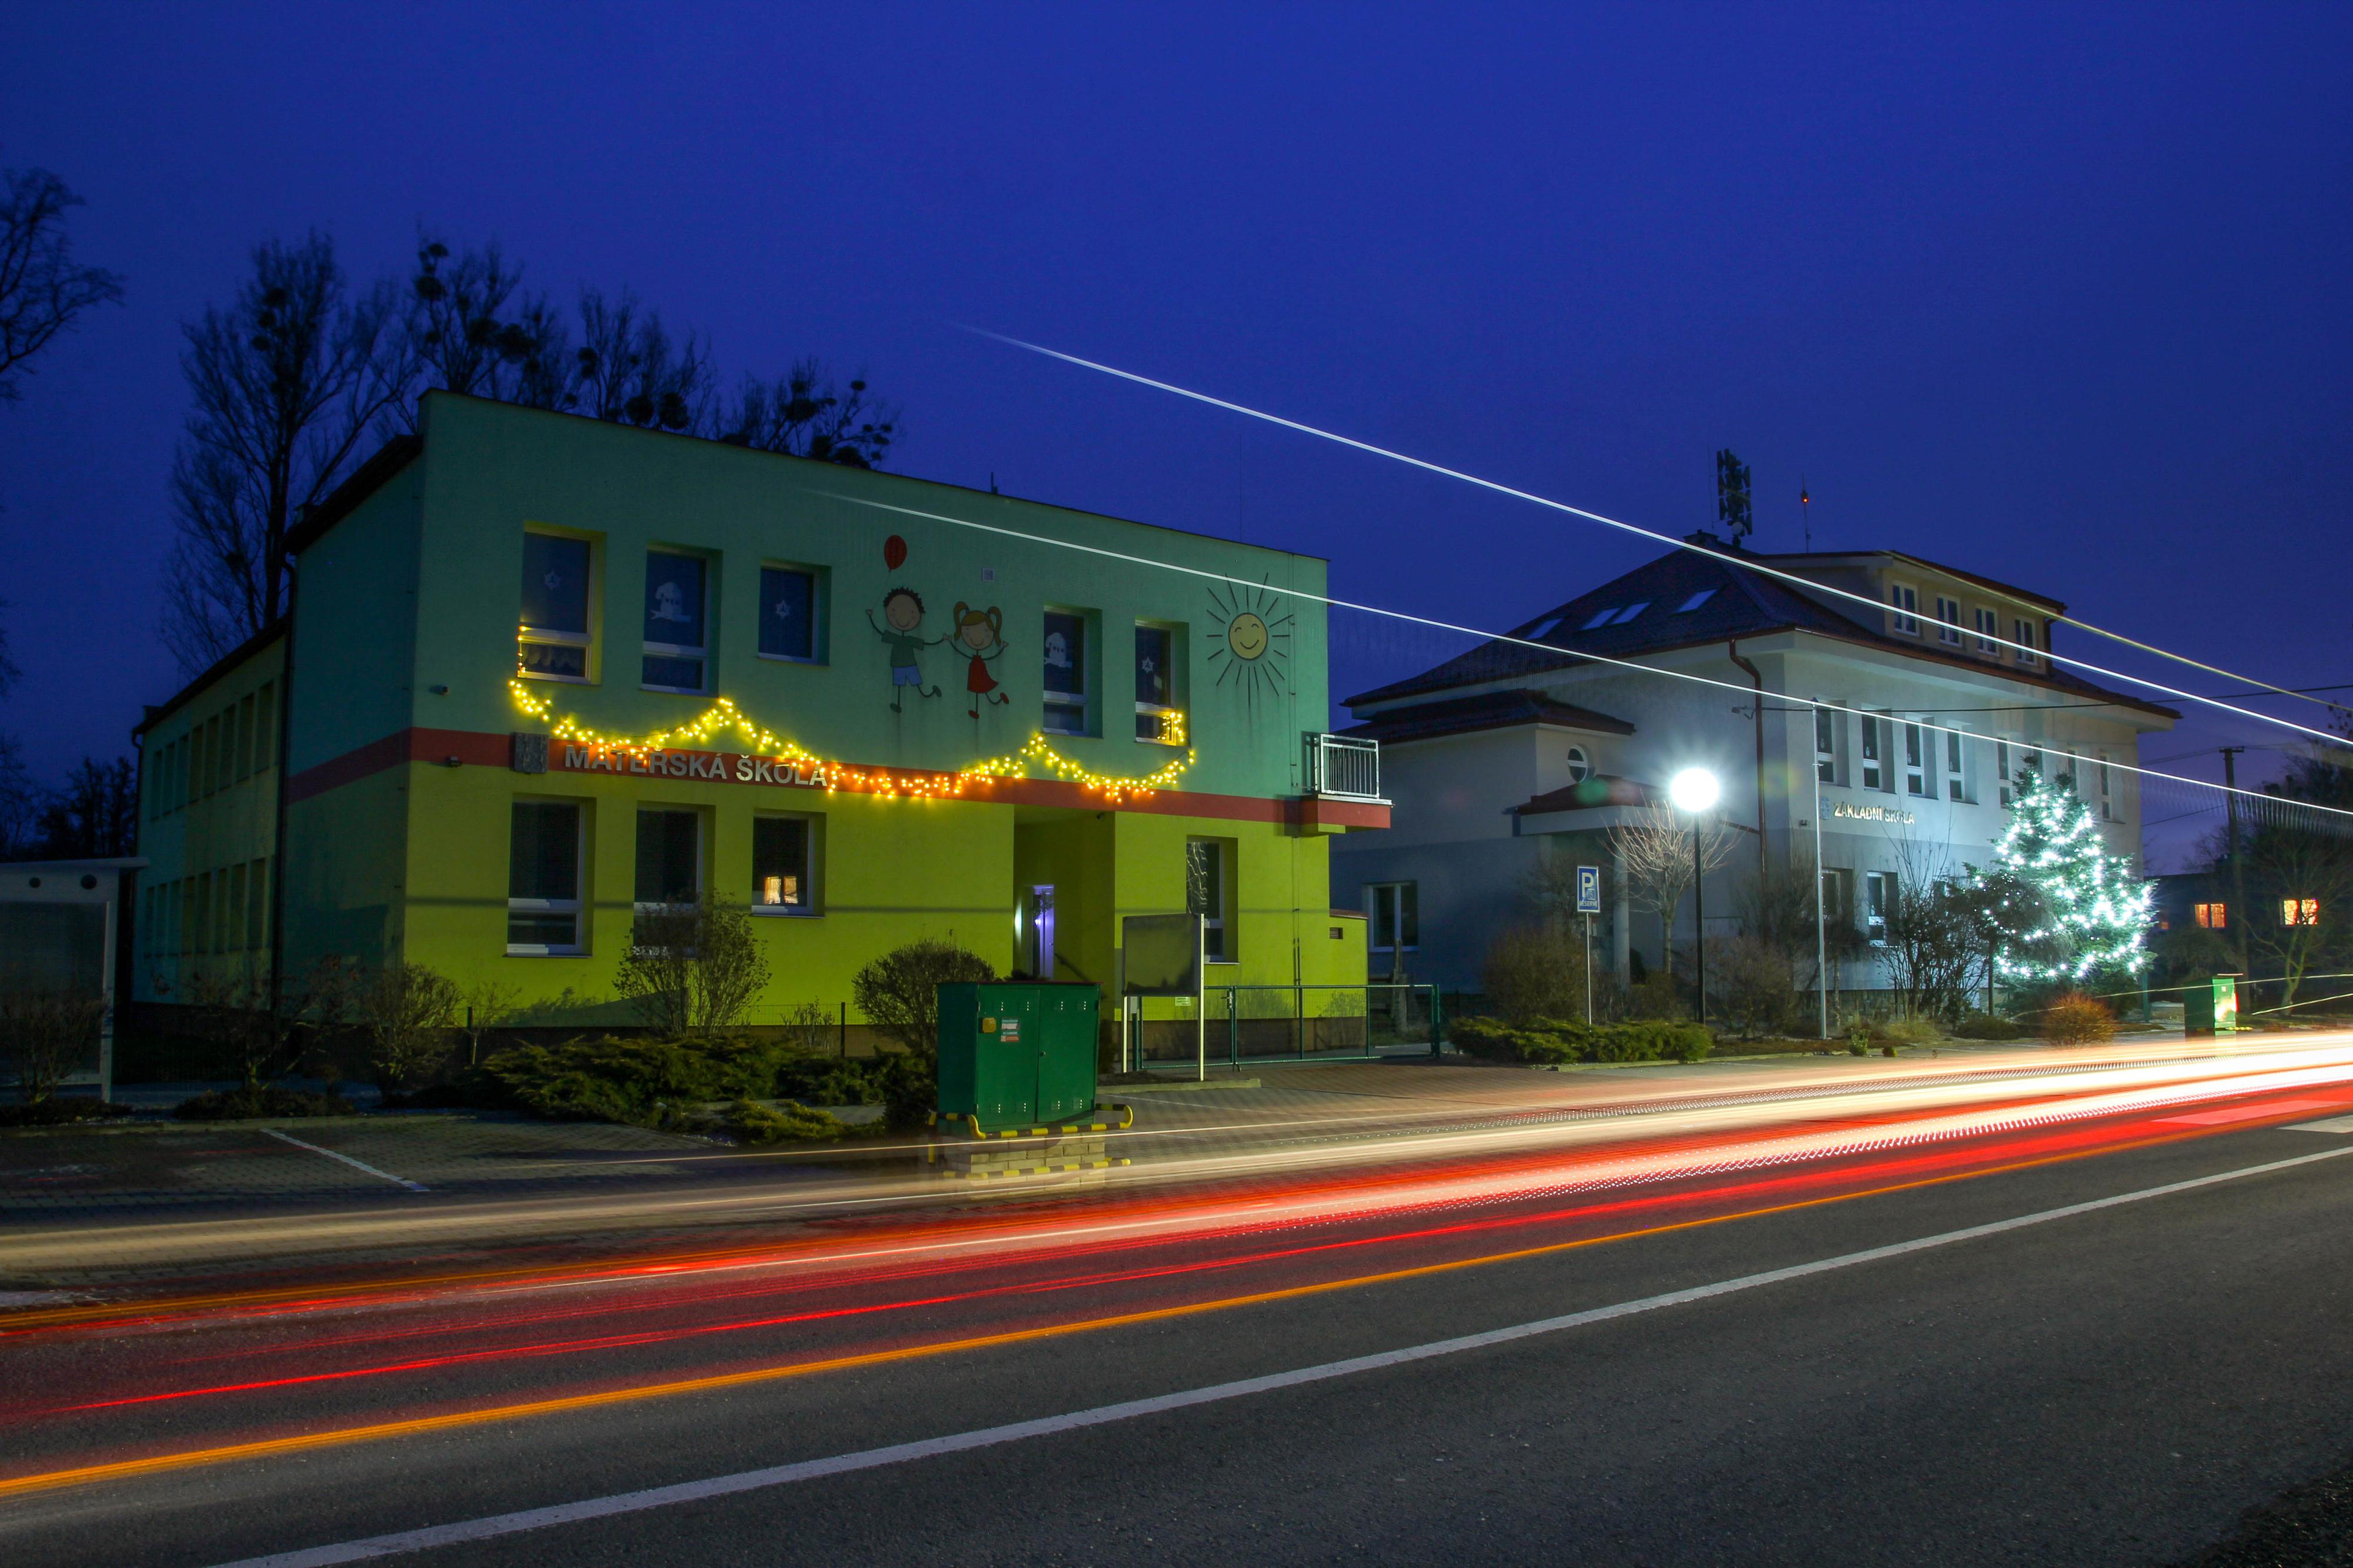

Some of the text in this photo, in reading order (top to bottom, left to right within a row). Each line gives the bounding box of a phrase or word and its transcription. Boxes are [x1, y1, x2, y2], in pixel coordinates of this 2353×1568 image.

[565, 745, 828, 787] MATEŘSKÁ ŠKOLA
[1834, 801, 1914, 824] ZÁKLADNÍ ŠKOLA
[1582, 873, 1594, 898] P
